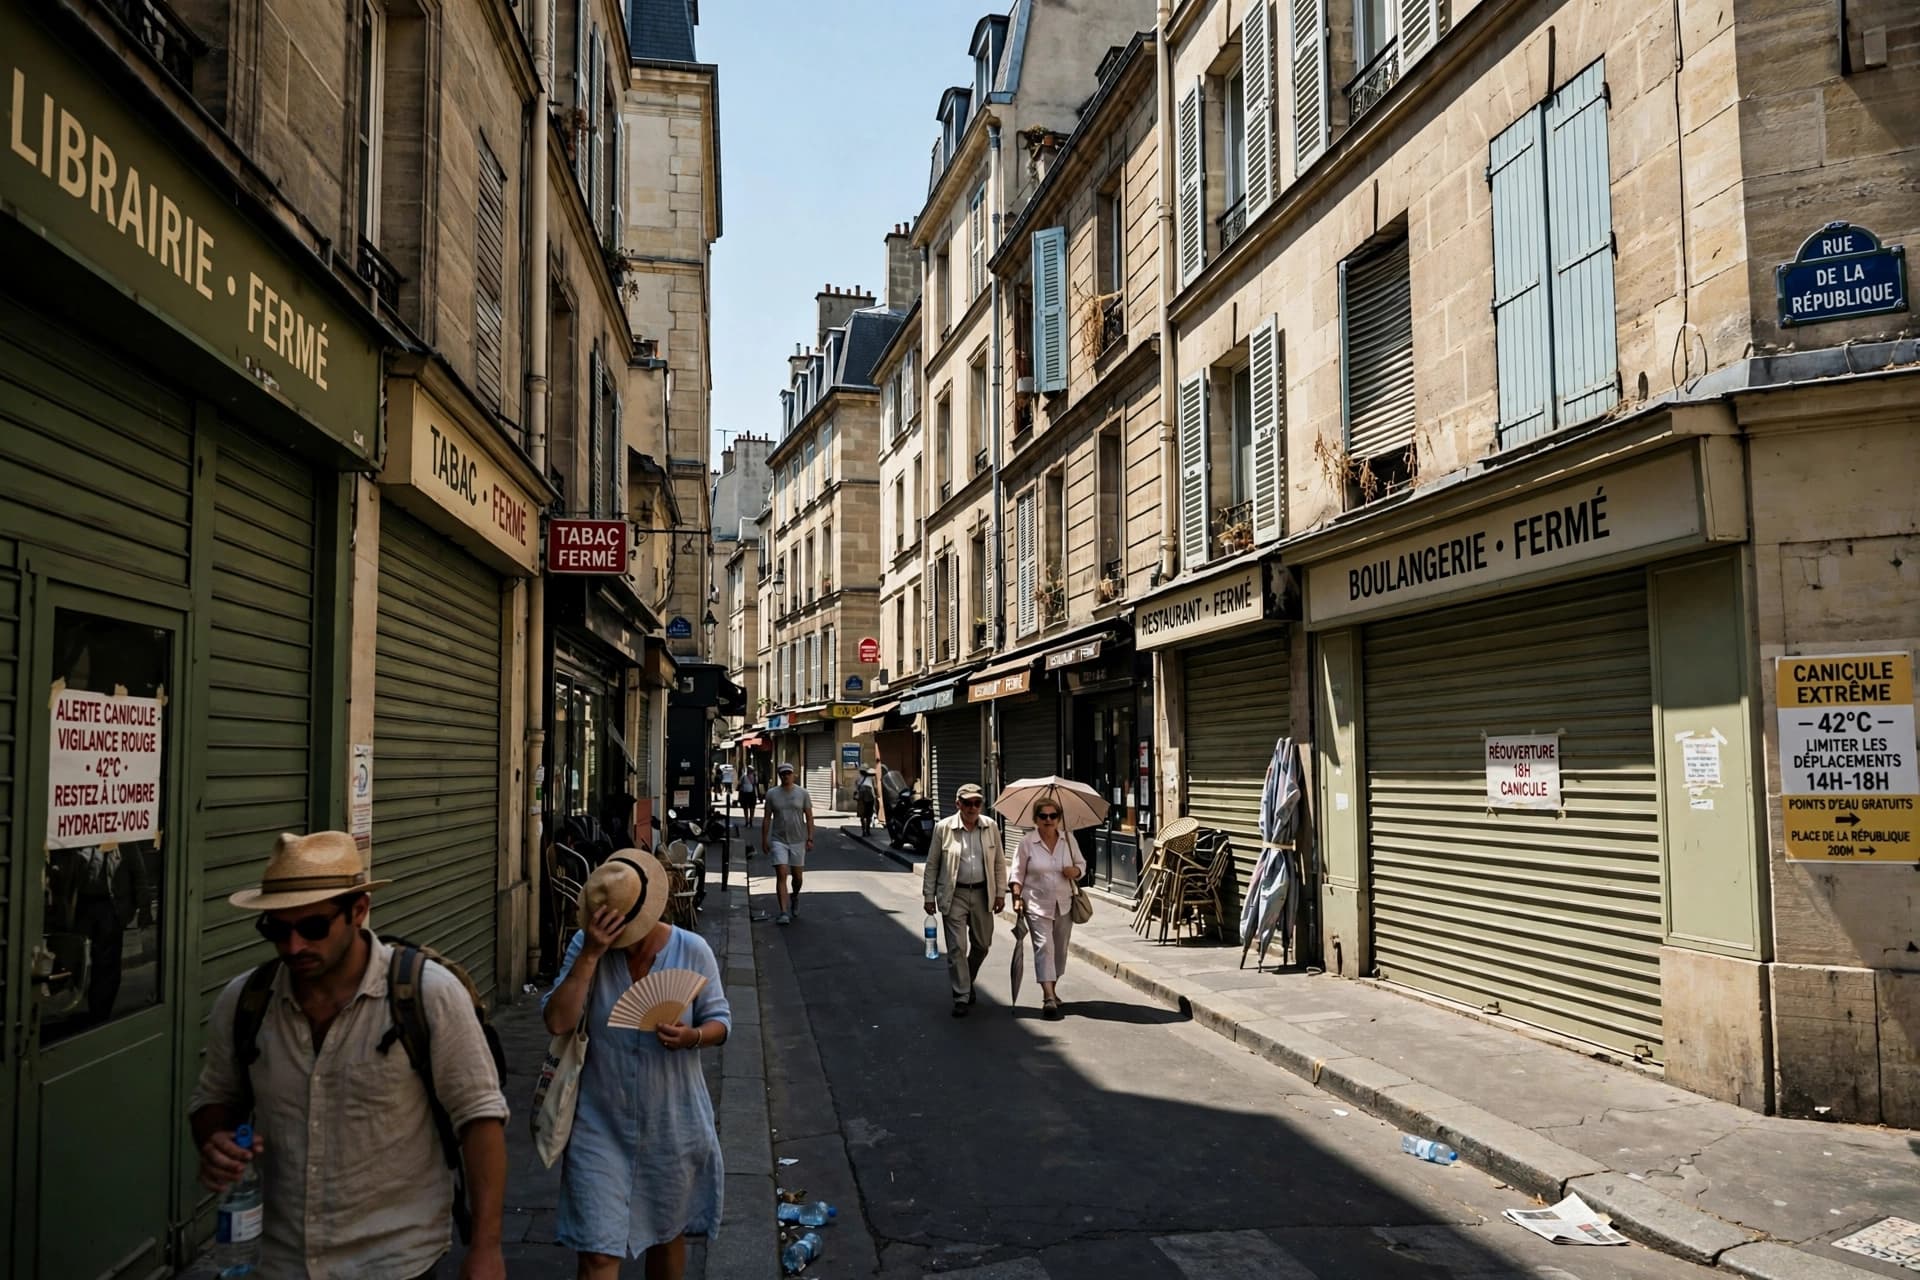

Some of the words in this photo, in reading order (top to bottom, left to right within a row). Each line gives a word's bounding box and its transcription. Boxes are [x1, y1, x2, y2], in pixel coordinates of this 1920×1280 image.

[11, 68, 215, 300] LIBRAIRIE
[248, 271, 329, 391] FERMÉ
[1822, 236, 1853, 255] RUE
[1816, 268, 1838, 286] DE
[1844, 264, 1864, 282] LA
[1792, 282, 1895, 313] RÉPUBLIQUE
[430, 424, 477, 506] TABAC
[493, 483, 527, 546] FERMÉ
[557, 527, 620, 545] TABAC
[1349, 531, 1487, 600] BOULANGERIE
[1514, 486, 1610, 560] FERMÉ
[559, 546, 617, 567] FERMÉ
[1142, 597, 1202, 635] RESTAURANT
[1213, 576, 1252, 616] FERMÉ
[1793, 661, 1894, 682] CANICULE
[1797, 680, 1891, 703] EXTRÊME
[56, 699, 101, 723] ALERTE
[104, 703, 156, 726] CANICULE
[1818, 711, 1872, 733] 42°C
[58, 728, 118, 751] VIGILANCE
[121, 732, 156, 753] ROUGE
[1489, 742, 1555, 759] RÉOUVERTURE
[1806, 738, 1859, 752] LIMITER
[1862, 738, 1887, 751] LES
[95, 757, 121, 777] 42°C
[1513, 763, 1531, 777] 18H
[1793, 752, 1902, 768] DÉPLACEMENTS
[1501, 780, 1548, 796] CANICULE
[1806, 771, 1889, 790] 14H-18H
[55, 784, 99, 806] RESTEZ
[112, 783, 155, 804] L'OMBRE
[1789, 798, 1826, 810] POINTS
[1828, 798, 1859, 810] D'EAU
[1861, 798, 1913, 810] GRATUITS
[57, 810, 150, 837] HYDRATEZ-VOUS
[1791, 830, 1820, 841] PLACE
[1822, 830, 1834, 841] DE
[1837, 831, 1848, 841] LA
[1851, 828, 1911, 844] RÉPUBLIQUE
[1828, 845, 1854, 856] 200M
